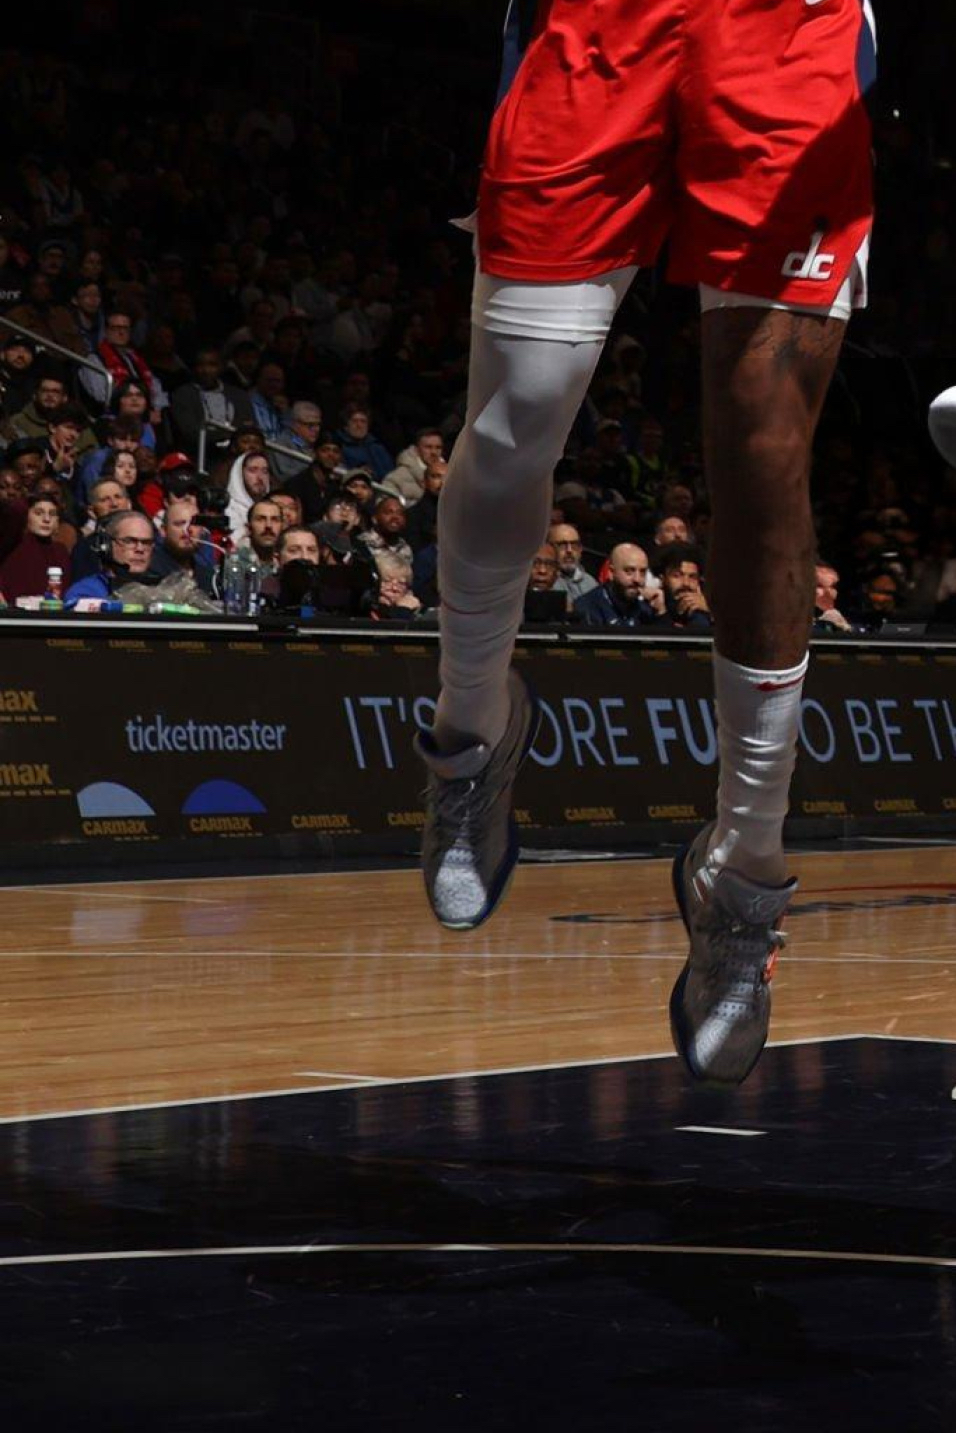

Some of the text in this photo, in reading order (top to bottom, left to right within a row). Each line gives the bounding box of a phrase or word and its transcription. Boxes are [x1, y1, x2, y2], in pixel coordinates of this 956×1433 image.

[125, 714, 287, 753] ticketmaster
[529, 697, 641, 767] ORE
[645, 697, 718, 766] FU
[801, 697, 836, 764] O
[844, 698, 914, 763] BE
